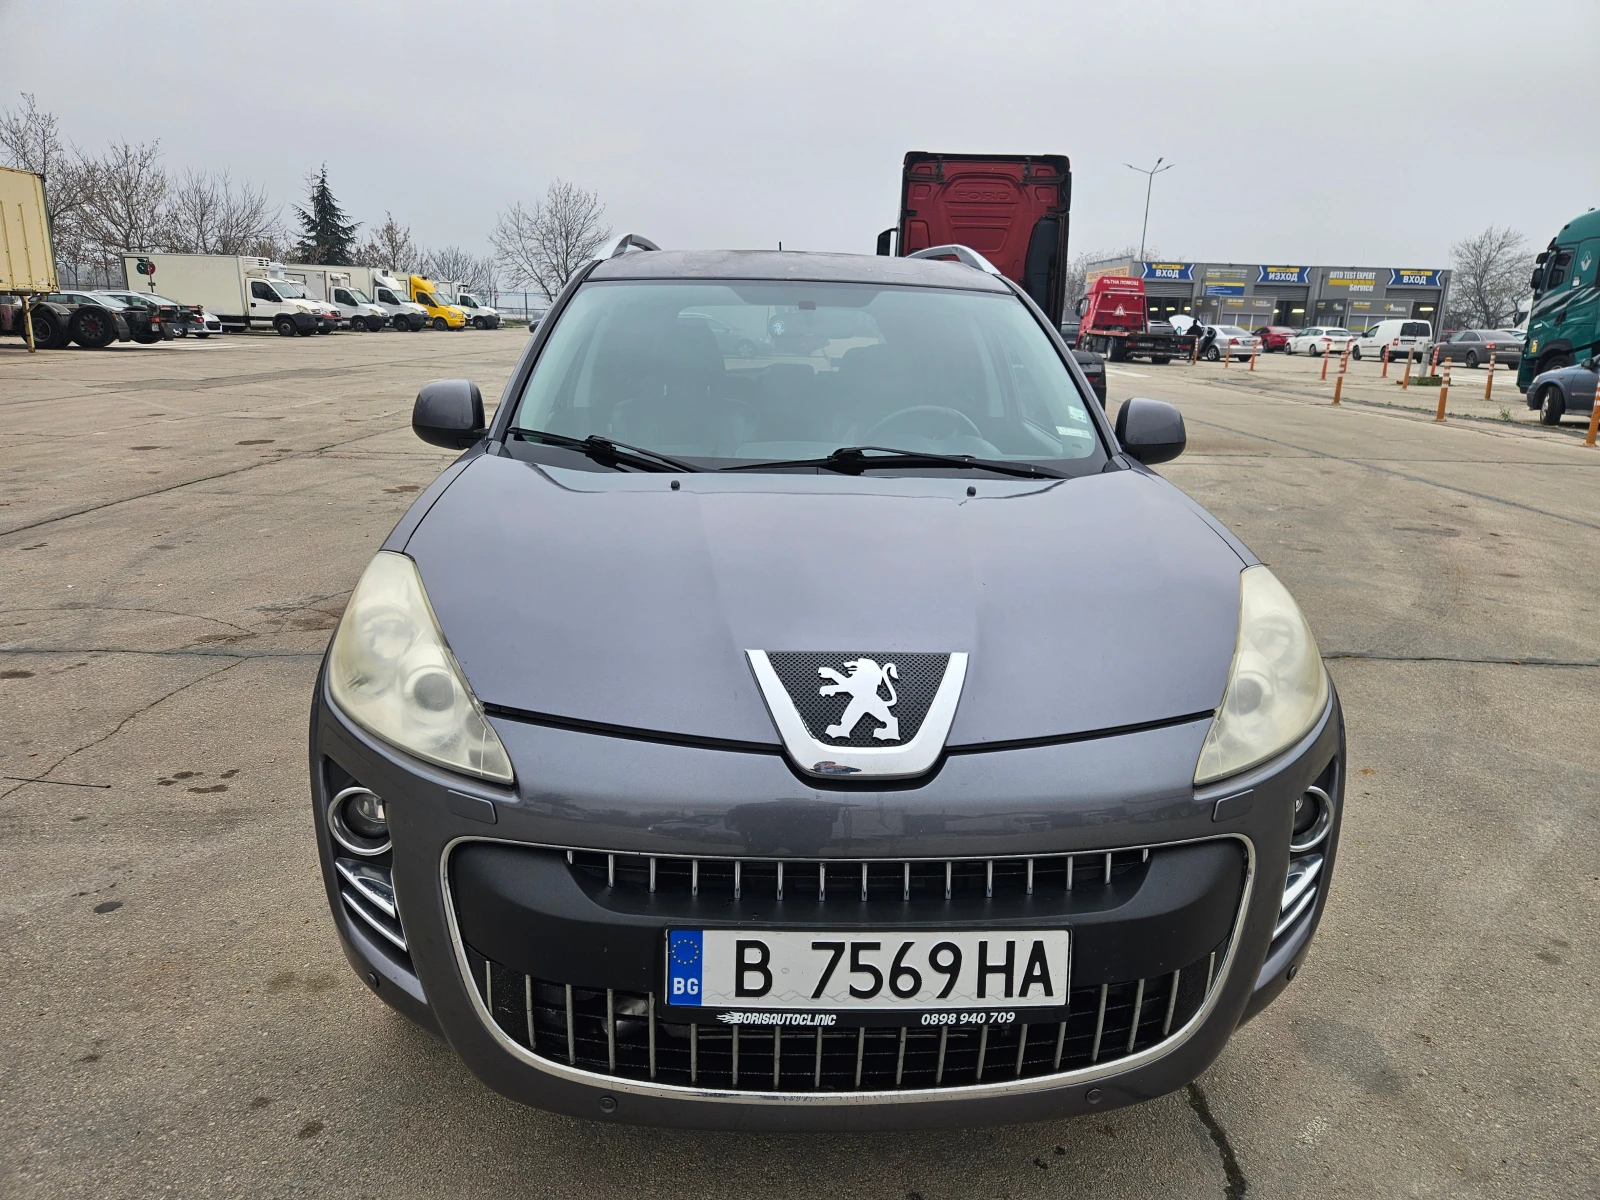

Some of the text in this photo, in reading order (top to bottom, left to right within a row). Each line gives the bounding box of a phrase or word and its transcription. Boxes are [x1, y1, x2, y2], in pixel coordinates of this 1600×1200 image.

[954, 190, 1011, 201] FORD
[1155, 269, 1180, 279] ВХОД
[1268, 272, 1298, 283] ИЗХОД
[1328, 270, 1376, 280] AUTO TEST EXPERT
[1402, 275, 1427, 285] ВХОД
[1348, 283, 1374, 292] Service
[735, 939, 773, 998] B
[673, 977, 699, 995] BG
[921, 1011, 1016, 1025] 0898 940 709
